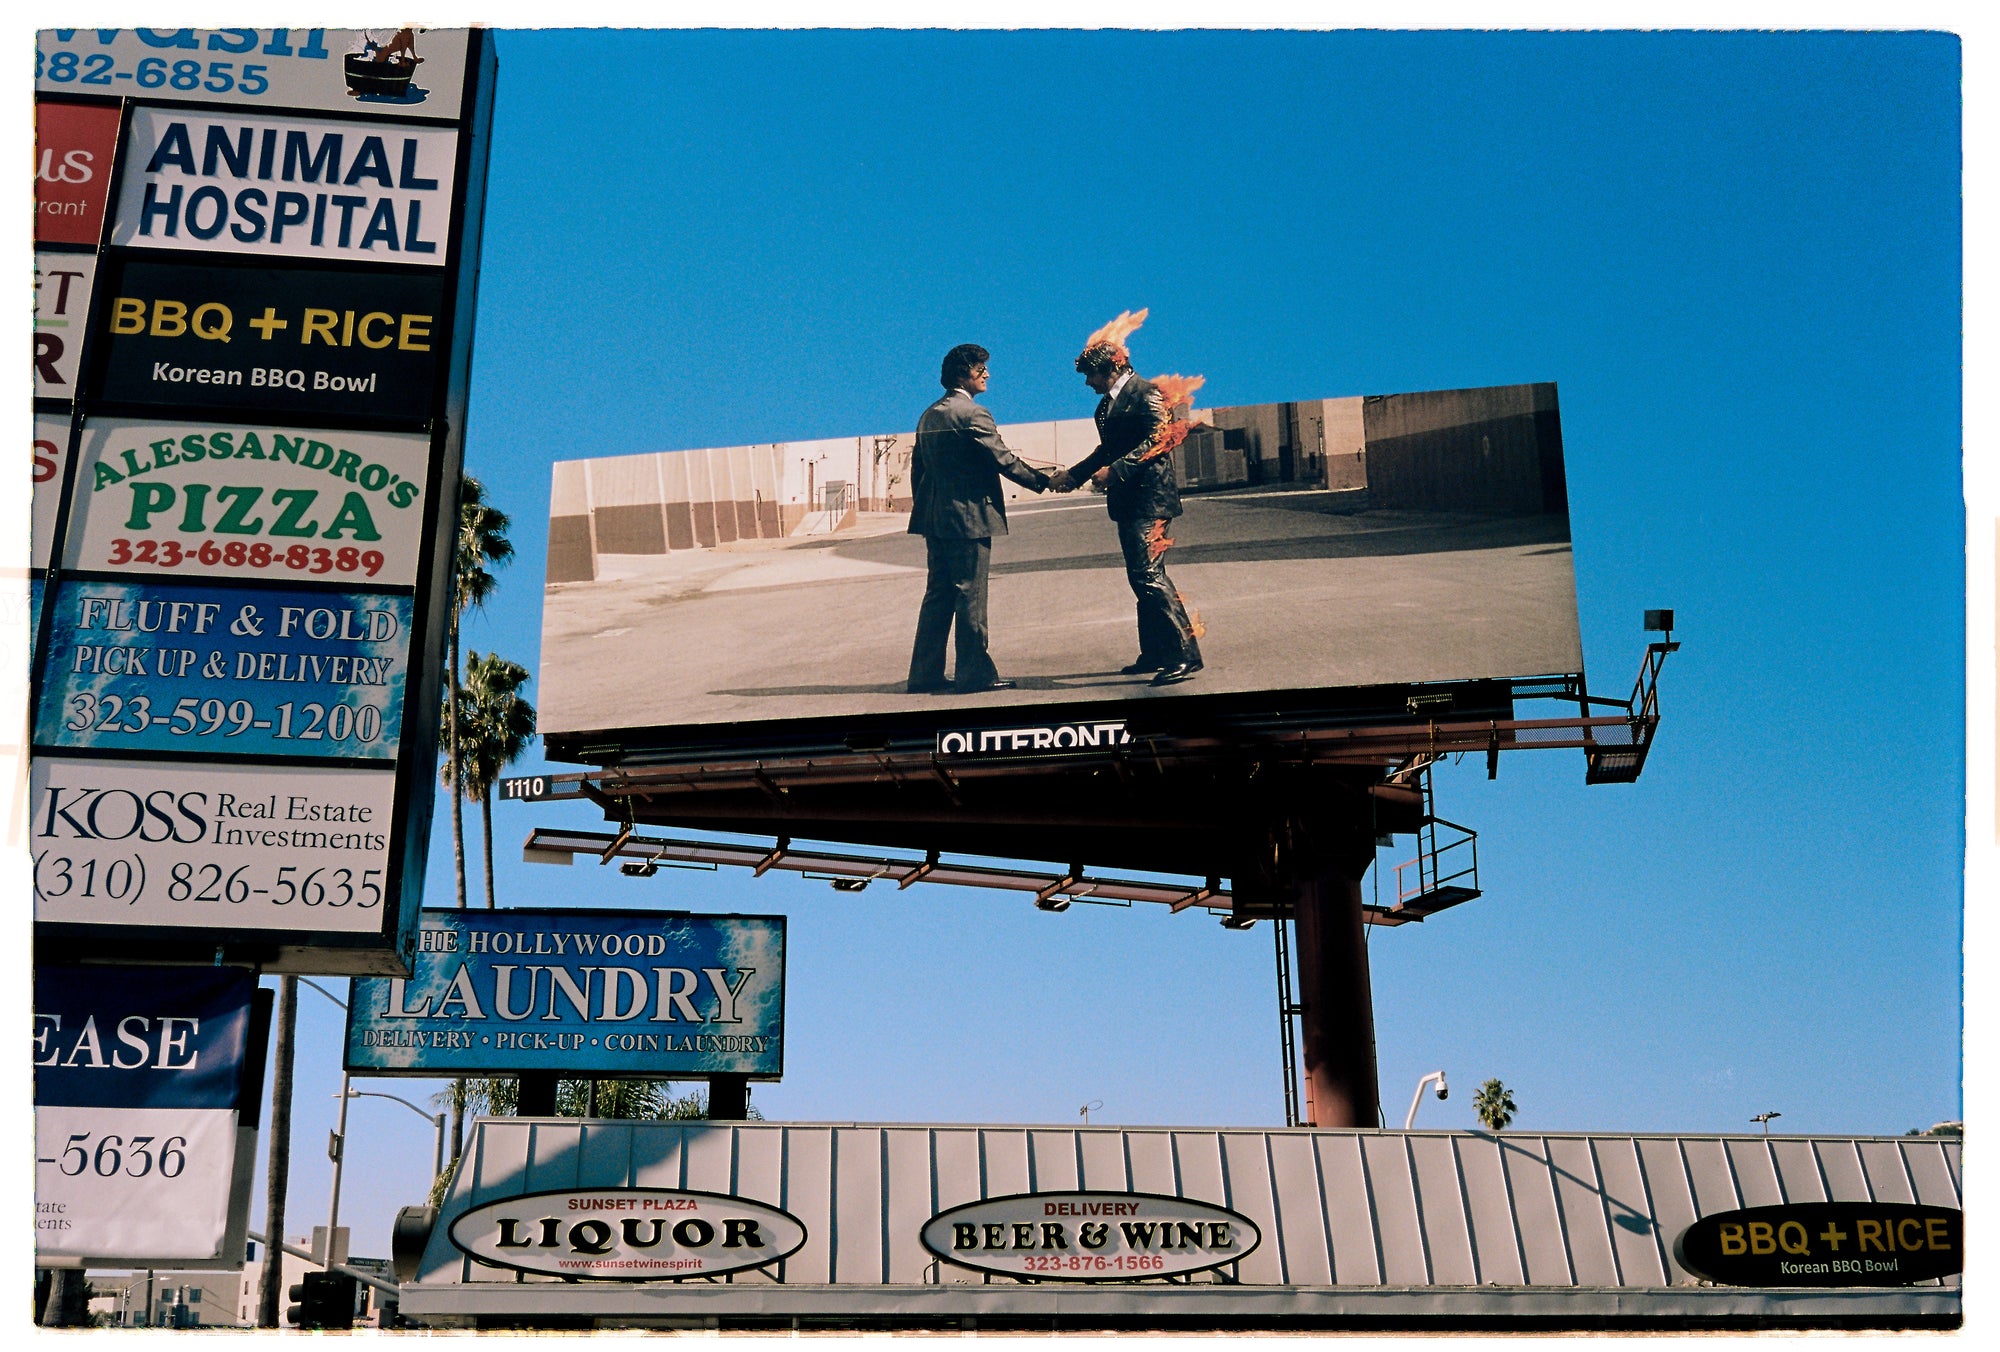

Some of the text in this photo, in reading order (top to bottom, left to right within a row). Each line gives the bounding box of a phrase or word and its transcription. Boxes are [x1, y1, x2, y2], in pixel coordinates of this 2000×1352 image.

[145, 122, 438, 191] ANIMAL
[138, 182, 437, 254] HOSPITAL
[109, 297, 433, 352] BBQ + RICE
[152, 361, 376, 393] Korean BBQ Bowl
[94, 432, 419, 508] ALESSANDRO'S
[125, 482, 382, 541] PIZZA
[107, 538, 384, 577] 323-688-8389
[79, 597, 398, 643] FLUFF & FOLD
[73, 645, 392, 686] PICK UP & DELIVERY
[66, 693, 382, 743] 323-599-1200
[506, 777, 544, 798] 1110
[37, 787, 373, 844] KOSS Real Estate
[211, 820, 386, 850] Investments
[33, 850, 383, 908] (310) 826-5635
[418, 930, 666, 957] HE HOLLYWOOD
[381, 962, 756, 1024] LAUNDRY
[361, 1029, 769, 1054] DELIVERY PICK-UP COIN LAUNDRY
[568, 1198, 698, 1212] SUNSET PLAZA
[1044, 1202, 1140, 1217] DELIVERY
[495, 1217, 766, 1255] LIQUOR
[952, 1221, 1233, 1251] BEER & WINE
[1719, 1218, 1952, 1257] BBQ + RICE
[558, 1258, 703, 1271] www.sunsetwinespirit
[1024, 1255, 1164, 1272] 323-876-1566
[1781, 1257, 1899, 1275] Korean BBQ Bowl
